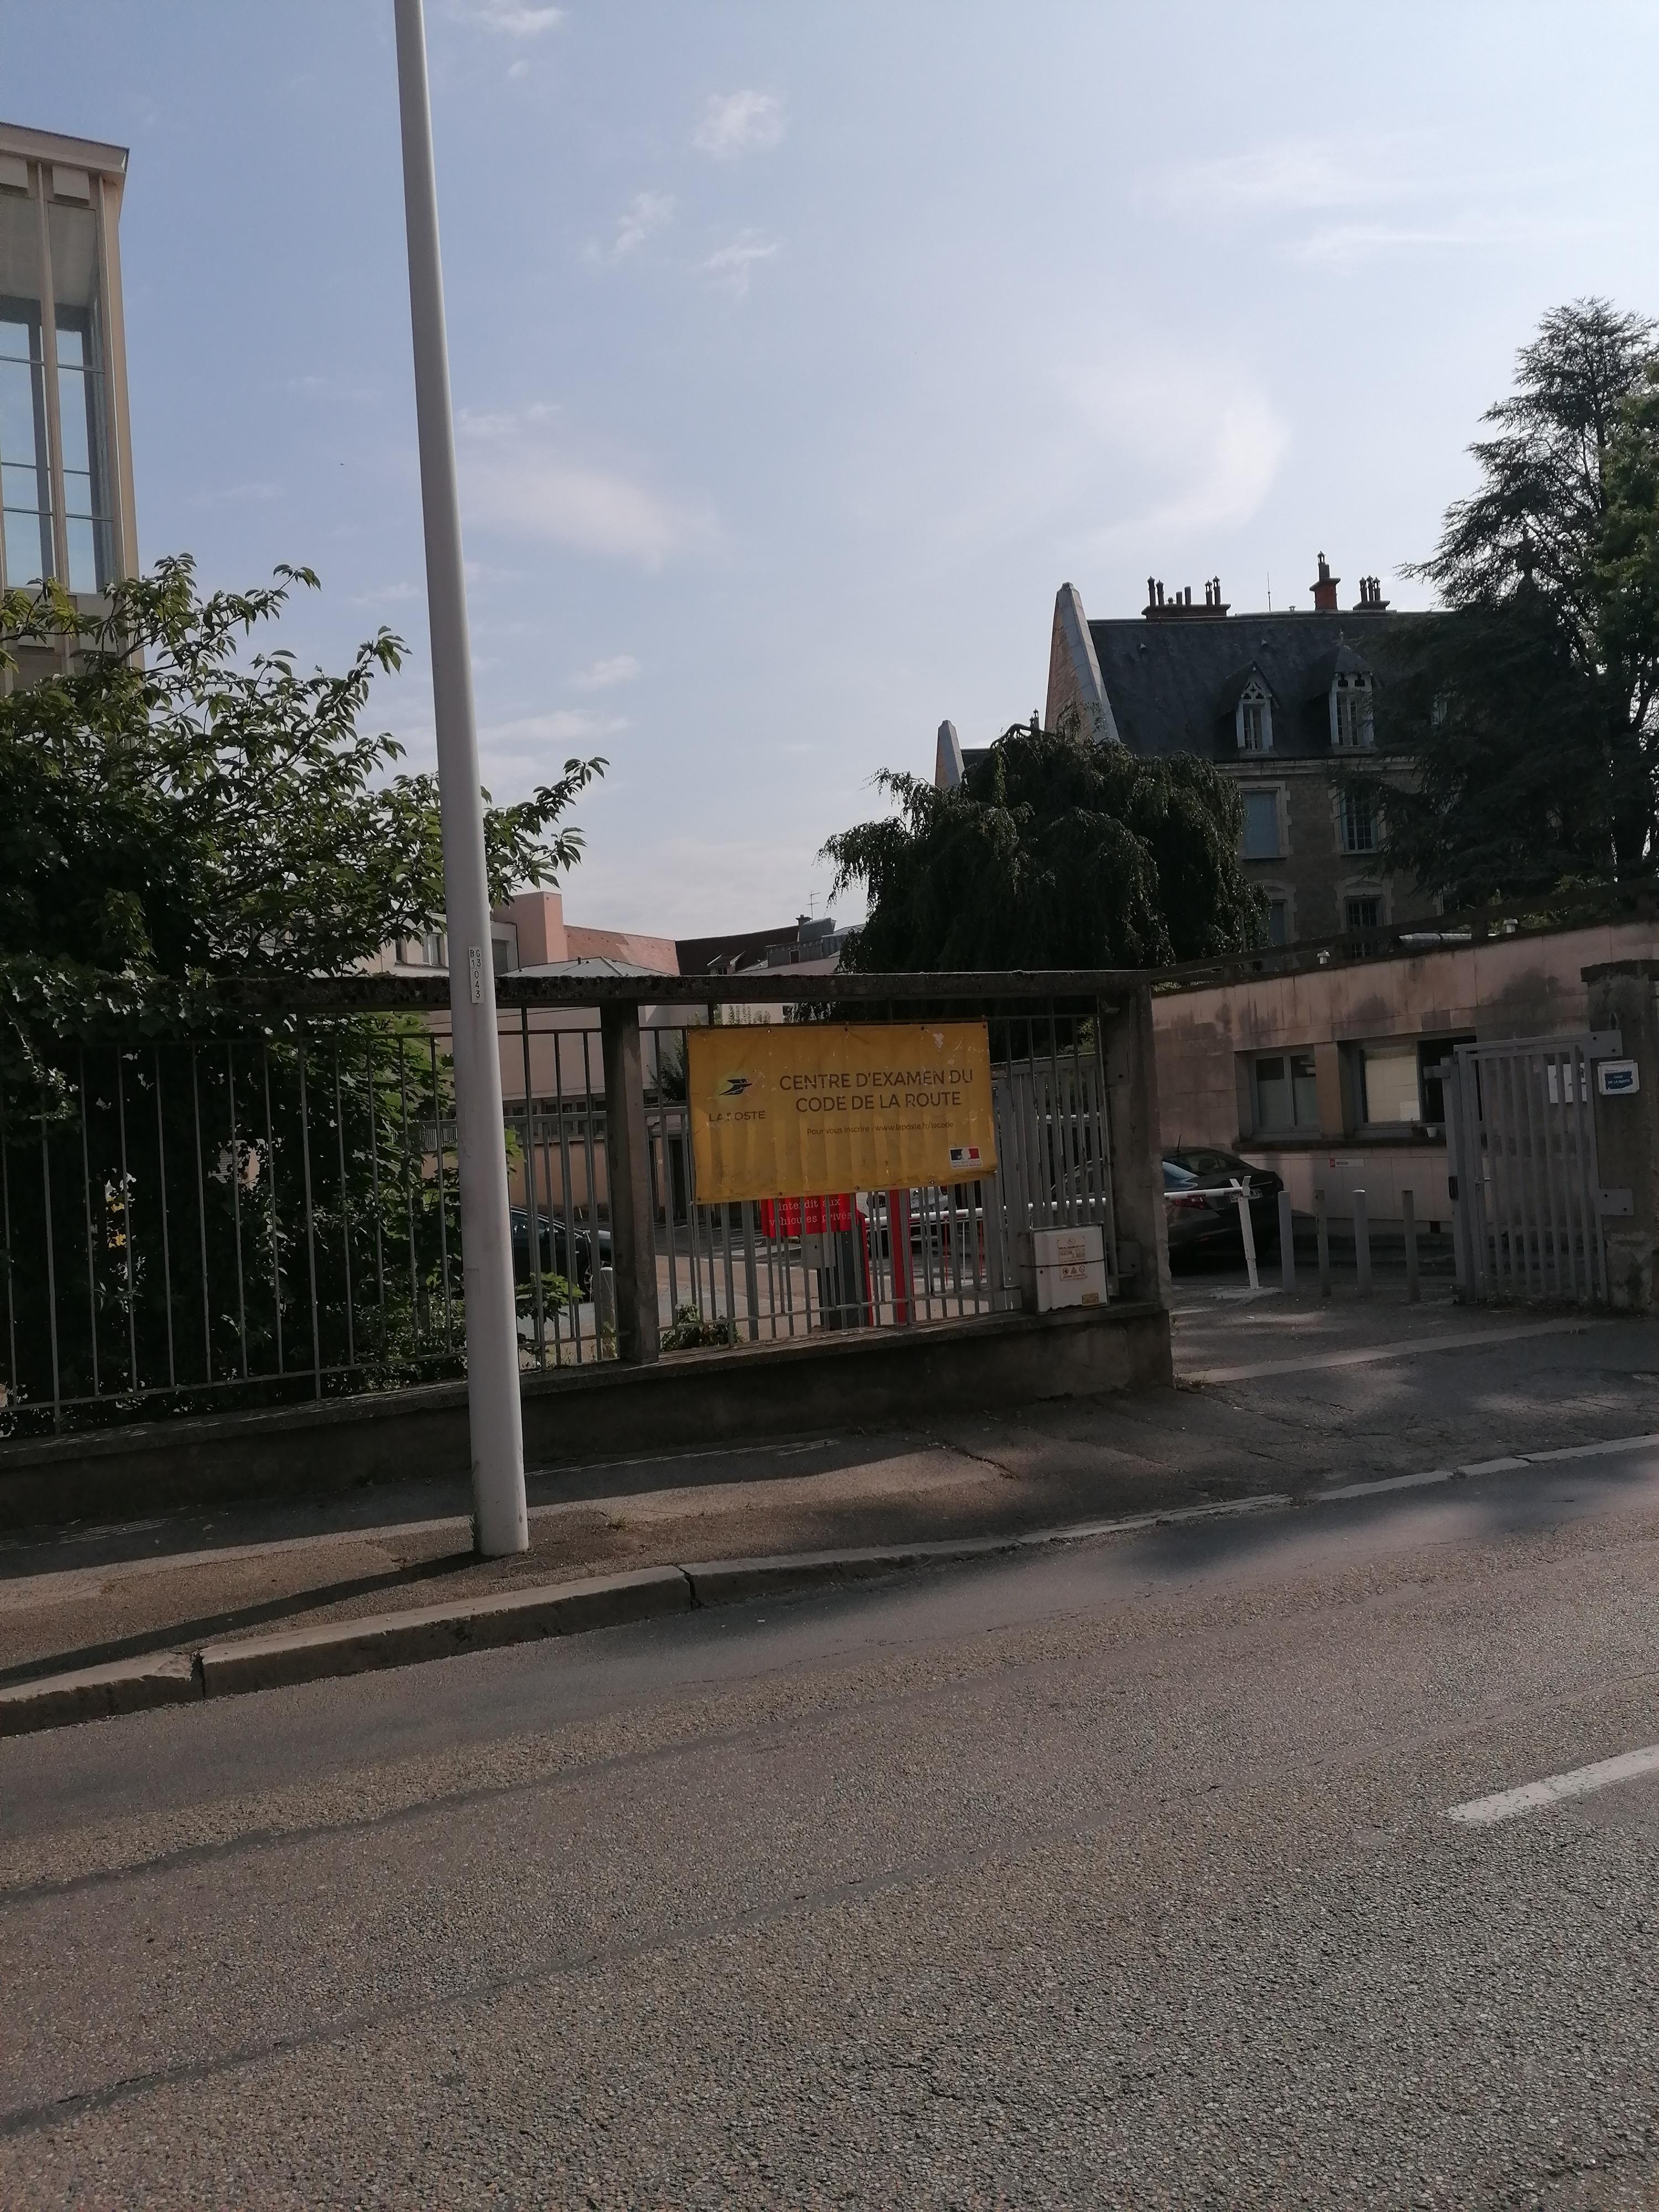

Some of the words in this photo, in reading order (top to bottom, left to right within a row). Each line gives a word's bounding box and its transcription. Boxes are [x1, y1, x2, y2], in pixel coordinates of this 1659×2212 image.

[779, 1073, 851, 1091] CENTRE
[856, 1070, 945, 1088] D'EXAMEN
[950, 1069, 973, 1084] DU
[796, 1095, 847, 1113] CODE
[852, 1095, 875, 1110] DE
[879, 1093, 901, 1109] LA
[905, 1091, 962, 1108] ROUTE
[779, 1198, 818, 1211] intedit
[769, 1215, 817, 1226] vhicues
